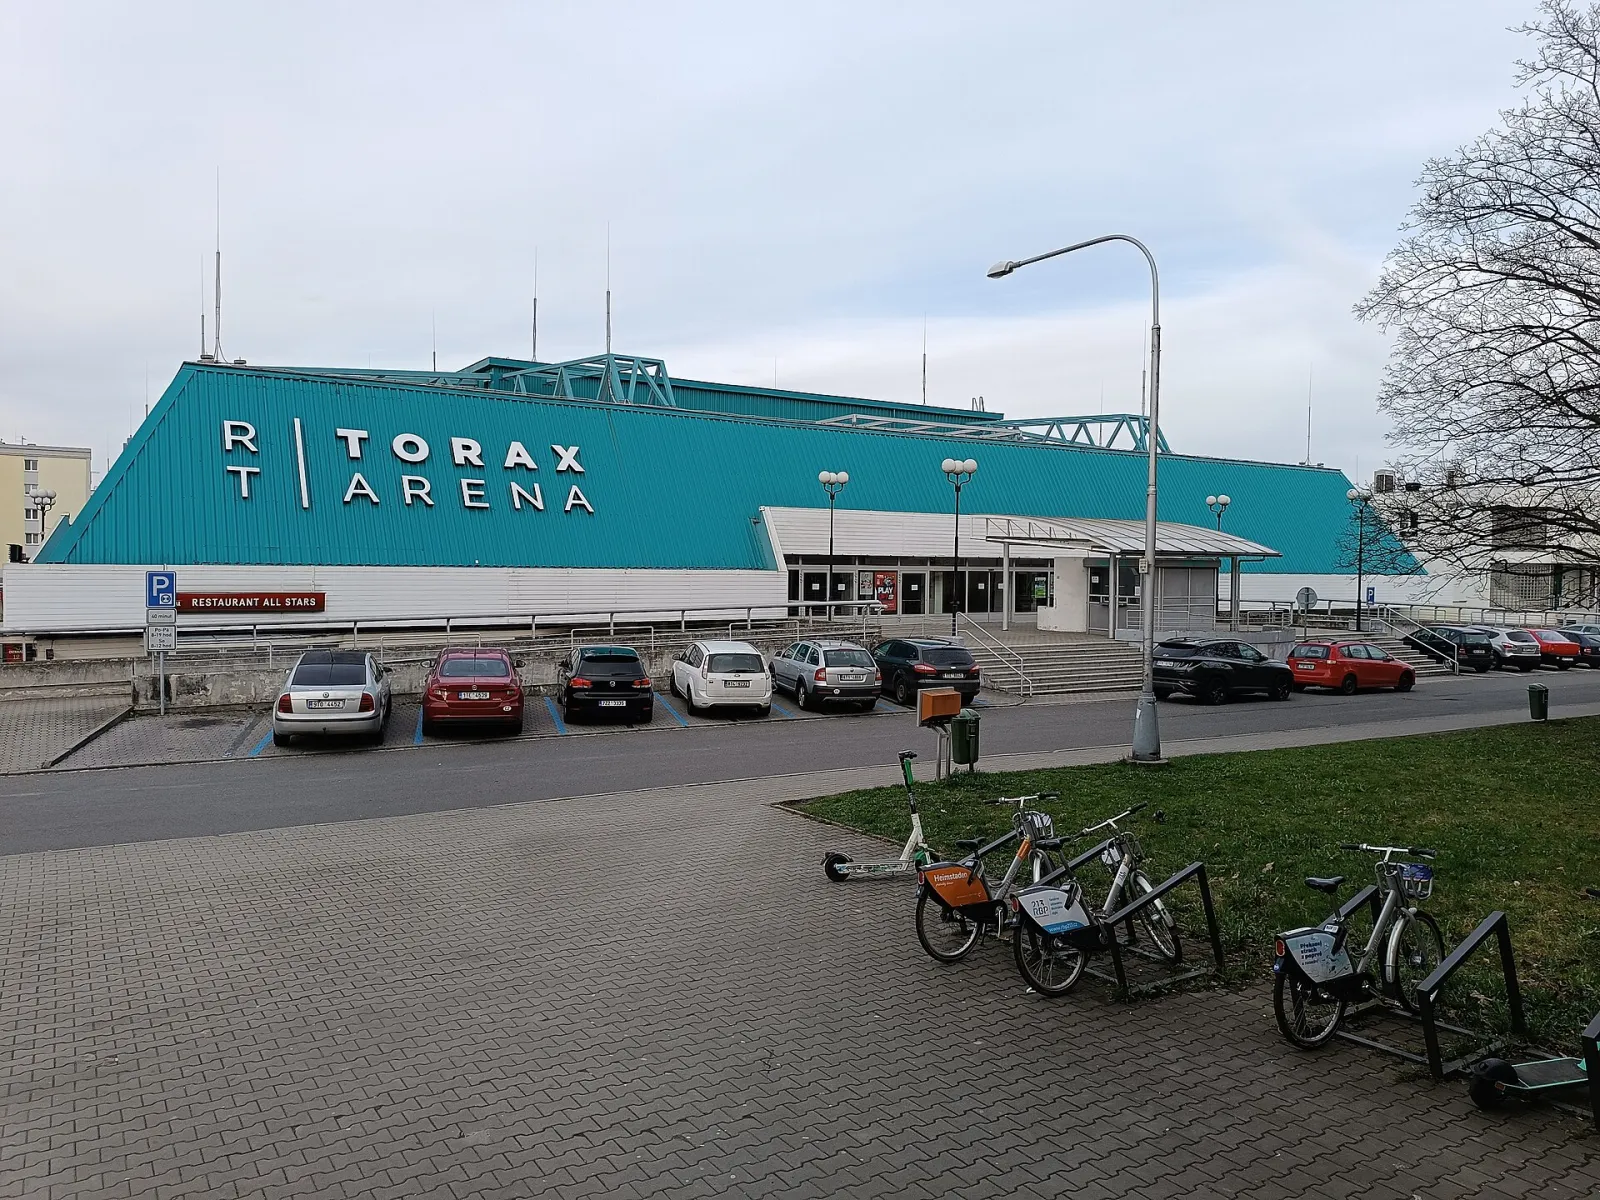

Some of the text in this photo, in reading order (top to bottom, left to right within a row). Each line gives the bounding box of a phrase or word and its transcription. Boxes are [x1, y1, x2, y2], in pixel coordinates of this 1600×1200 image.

[223, 419, 259, 453] R
[335, 426, 586, 474] TORAX
[226, 465, 261, 499] T
[343, 471, 596, 514] ARENA
[153, 576, 169, 596] P
[192, 597, 316, 607] RESTAURANT ALL STARS
[877, 586, 893, 594] PLAY
